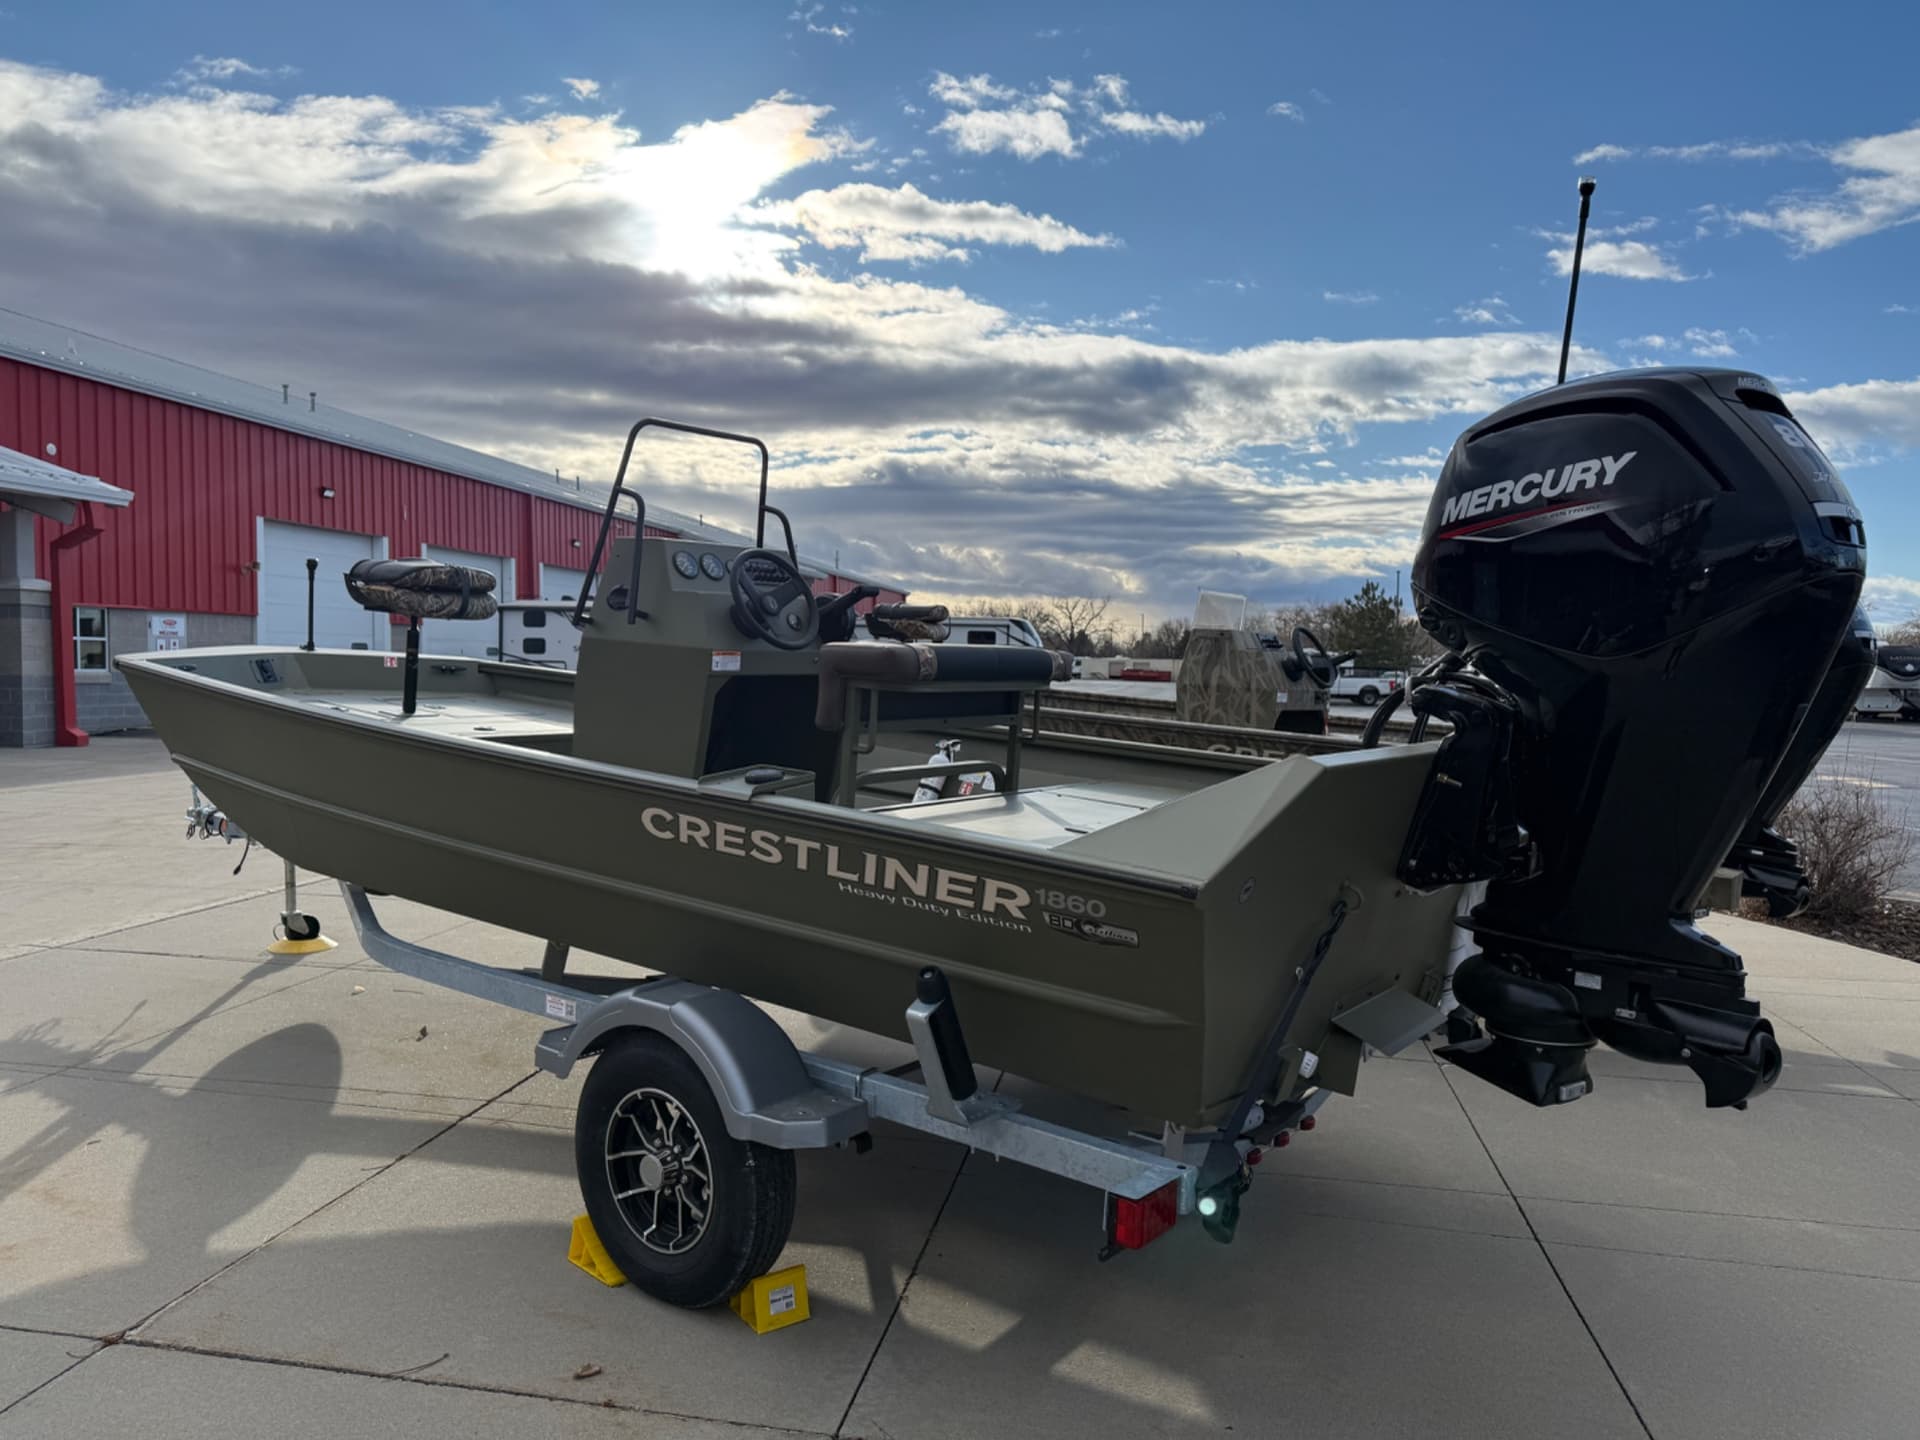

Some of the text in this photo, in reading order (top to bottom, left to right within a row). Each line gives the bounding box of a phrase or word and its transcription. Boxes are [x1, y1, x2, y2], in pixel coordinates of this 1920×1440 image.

[1441, 450, 1638, 526] MERCURY
[640, 806, 1032, 920] CRESTLINER
[838, 882, 1033, 934] Heavy Duty Edition
[1034, 888, 1107, 918] 1860
